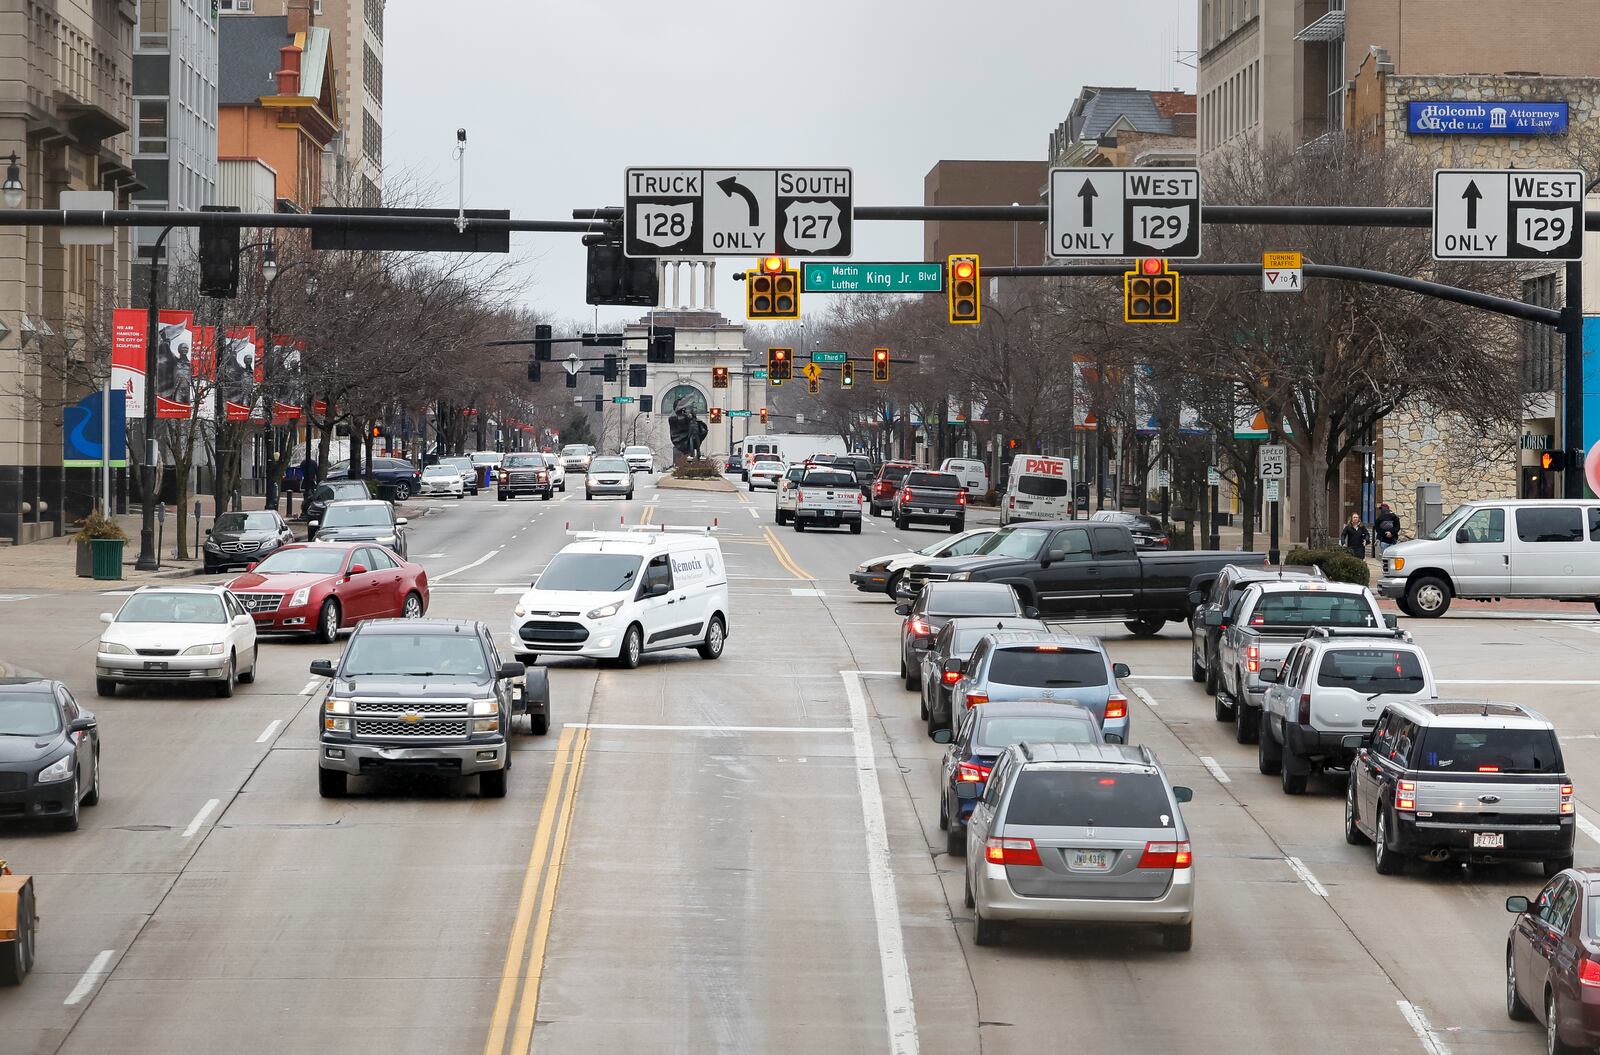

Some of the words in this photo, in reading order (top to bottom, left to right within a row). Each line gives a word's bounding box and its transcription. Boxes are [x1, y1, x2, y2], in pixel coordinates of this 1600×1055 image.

[1427, 106, 1486, 117] Holcomb
[1510, 109, 1560, 120] Attorneys
[1430, 117, 1464, 132] Hyde
[1516, 118, 1528, 126] At
[1531, 118, 1552, 126] Law
[632, 173, 698, 192] TRUCK
[780, 173, 846, 194] SOUTH
[1130, 176, 1192, 196] WEST
[1514, 178, 1576, 198] WEST
[644, 212, 686, 236] 128
[792, 215, 833, 239] 127
[1140, 216, 1182, 239] 129
[1524, 218, 1566, 241] 129
[712, 232, 766, 248] ONLY
[1061, 233, 1114, 250] ONLY
[1444, 235, 1498, 251] ONLY
[832, 266, 858, 276] Martin
[832, 280, 858, 289] Luther
[866, 272, 892, 287] King
[898, 272, 912, 284] Jr.
[918, 272, 937, 281] Blvd
[1519, 434, 1548, 450] FLORIST
[1026, 459, 1064, 475] PATE
[1262, 462, 1283, 475] 25
[672, 556, 702, 574] Remotix
[1488, 835, 1503, 845] 7214
